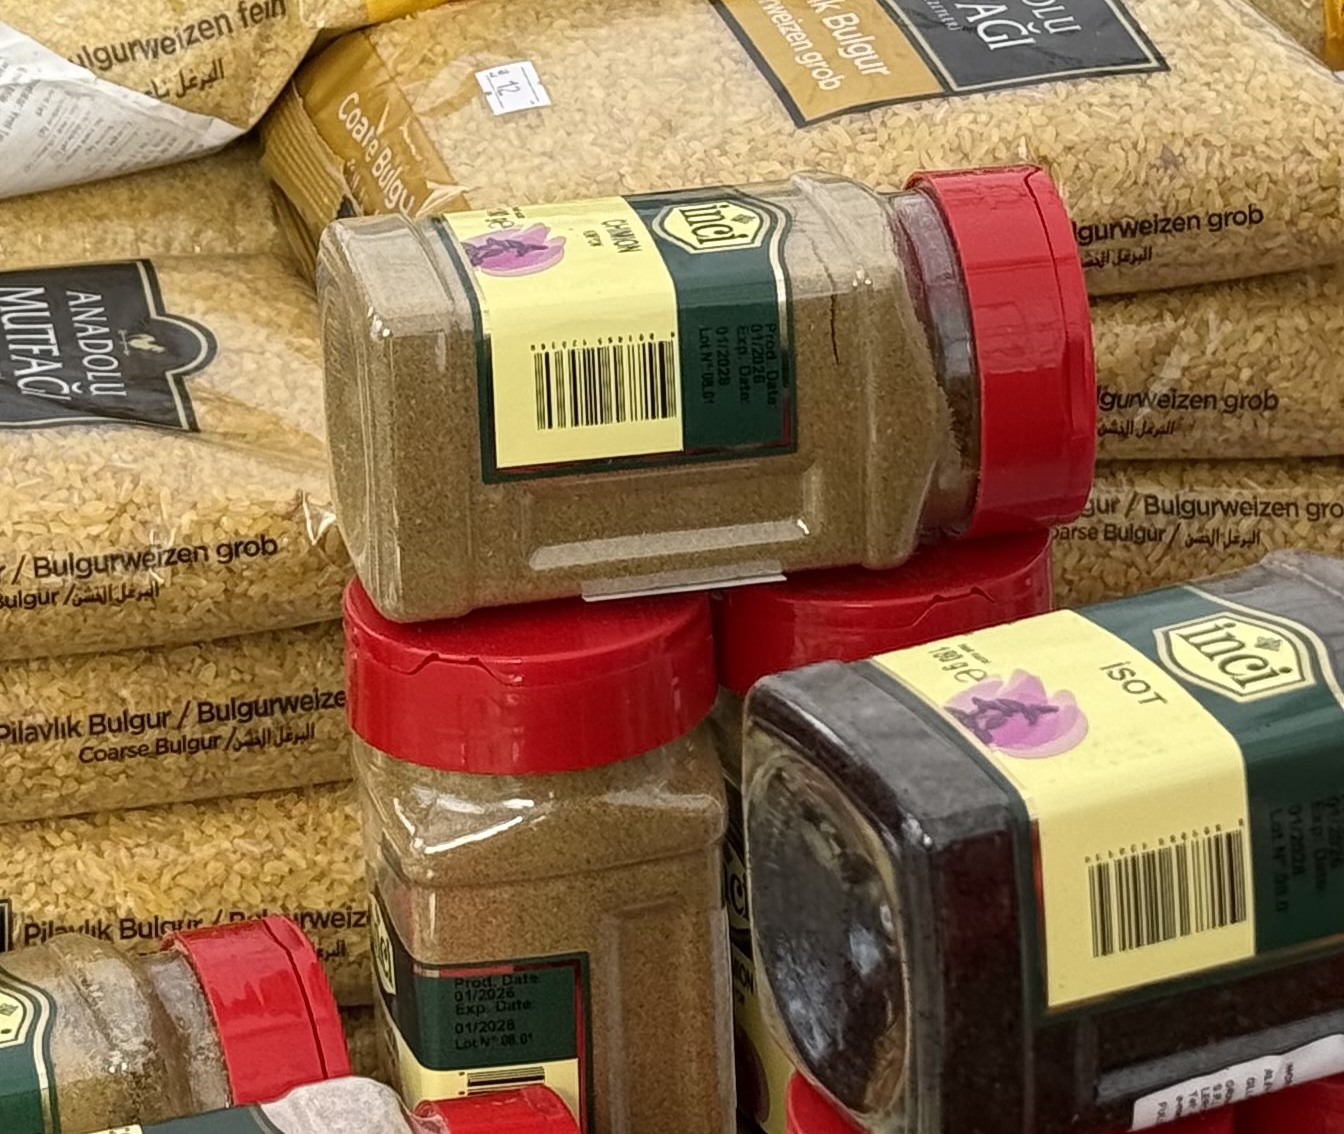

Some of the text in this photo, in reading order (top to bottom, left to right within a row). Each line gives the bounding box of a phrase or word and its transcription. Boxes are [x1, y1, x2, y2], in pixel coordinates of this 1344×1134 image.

[67, 9, 235, 74] ulgurweizen
[829, 11, 890, 77] Bulgur
[799, 42, 843, 92] grob
[1072, 204, 1265, 247] lgurweizen grob
[64, 288, 128, 399] ANADOLU
[716, 325, 731, 387] 01/2028
[1096, 384, 1280, 415] lgurweizen grob
[1143, 493, 1299, 522] Bulgurweizen
[1102, 520, 1166, 546] Bulgur
[33, 541, 209, 582] Bulgurweizen
[215, 533, 279, 567] grob
[88, 708, 173, 742] Bulgur
[197, 689, 348, 724] Bulgurweize
[79, 732, 219, 765] Coarse Bulgur
[454, 986, 516, 1003] 01/2026
[454, 1018, 516, 1035] 01/2028
